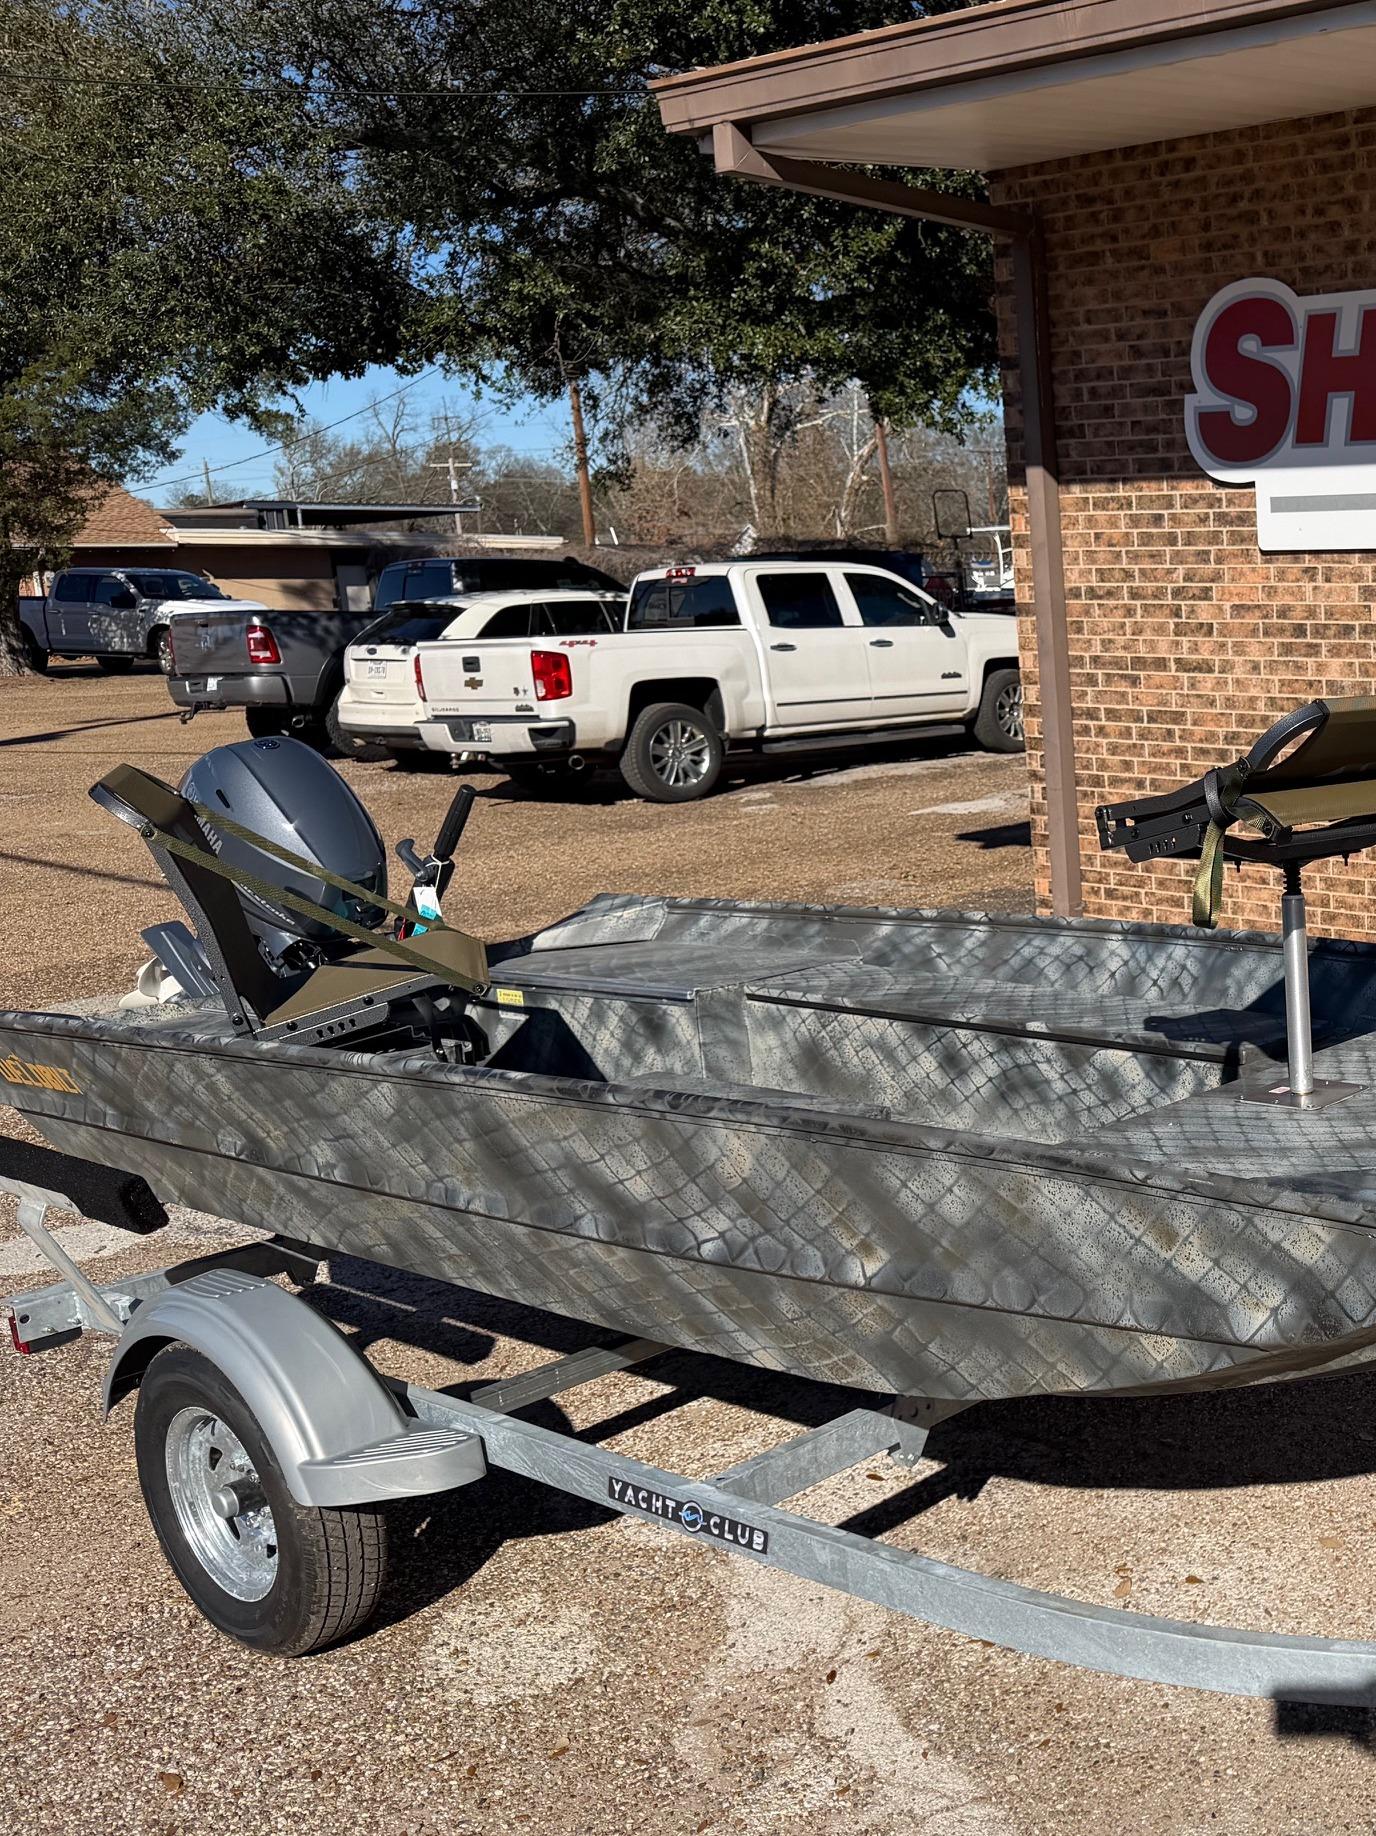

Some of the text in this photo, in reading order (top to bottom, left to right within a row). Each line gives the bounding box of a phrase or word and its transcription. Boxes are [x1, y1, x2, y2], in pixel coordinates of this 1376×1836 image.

[193, 813, 224, 856] MAHA
[611, 1479, 765, 1551] YACHT CLUB
